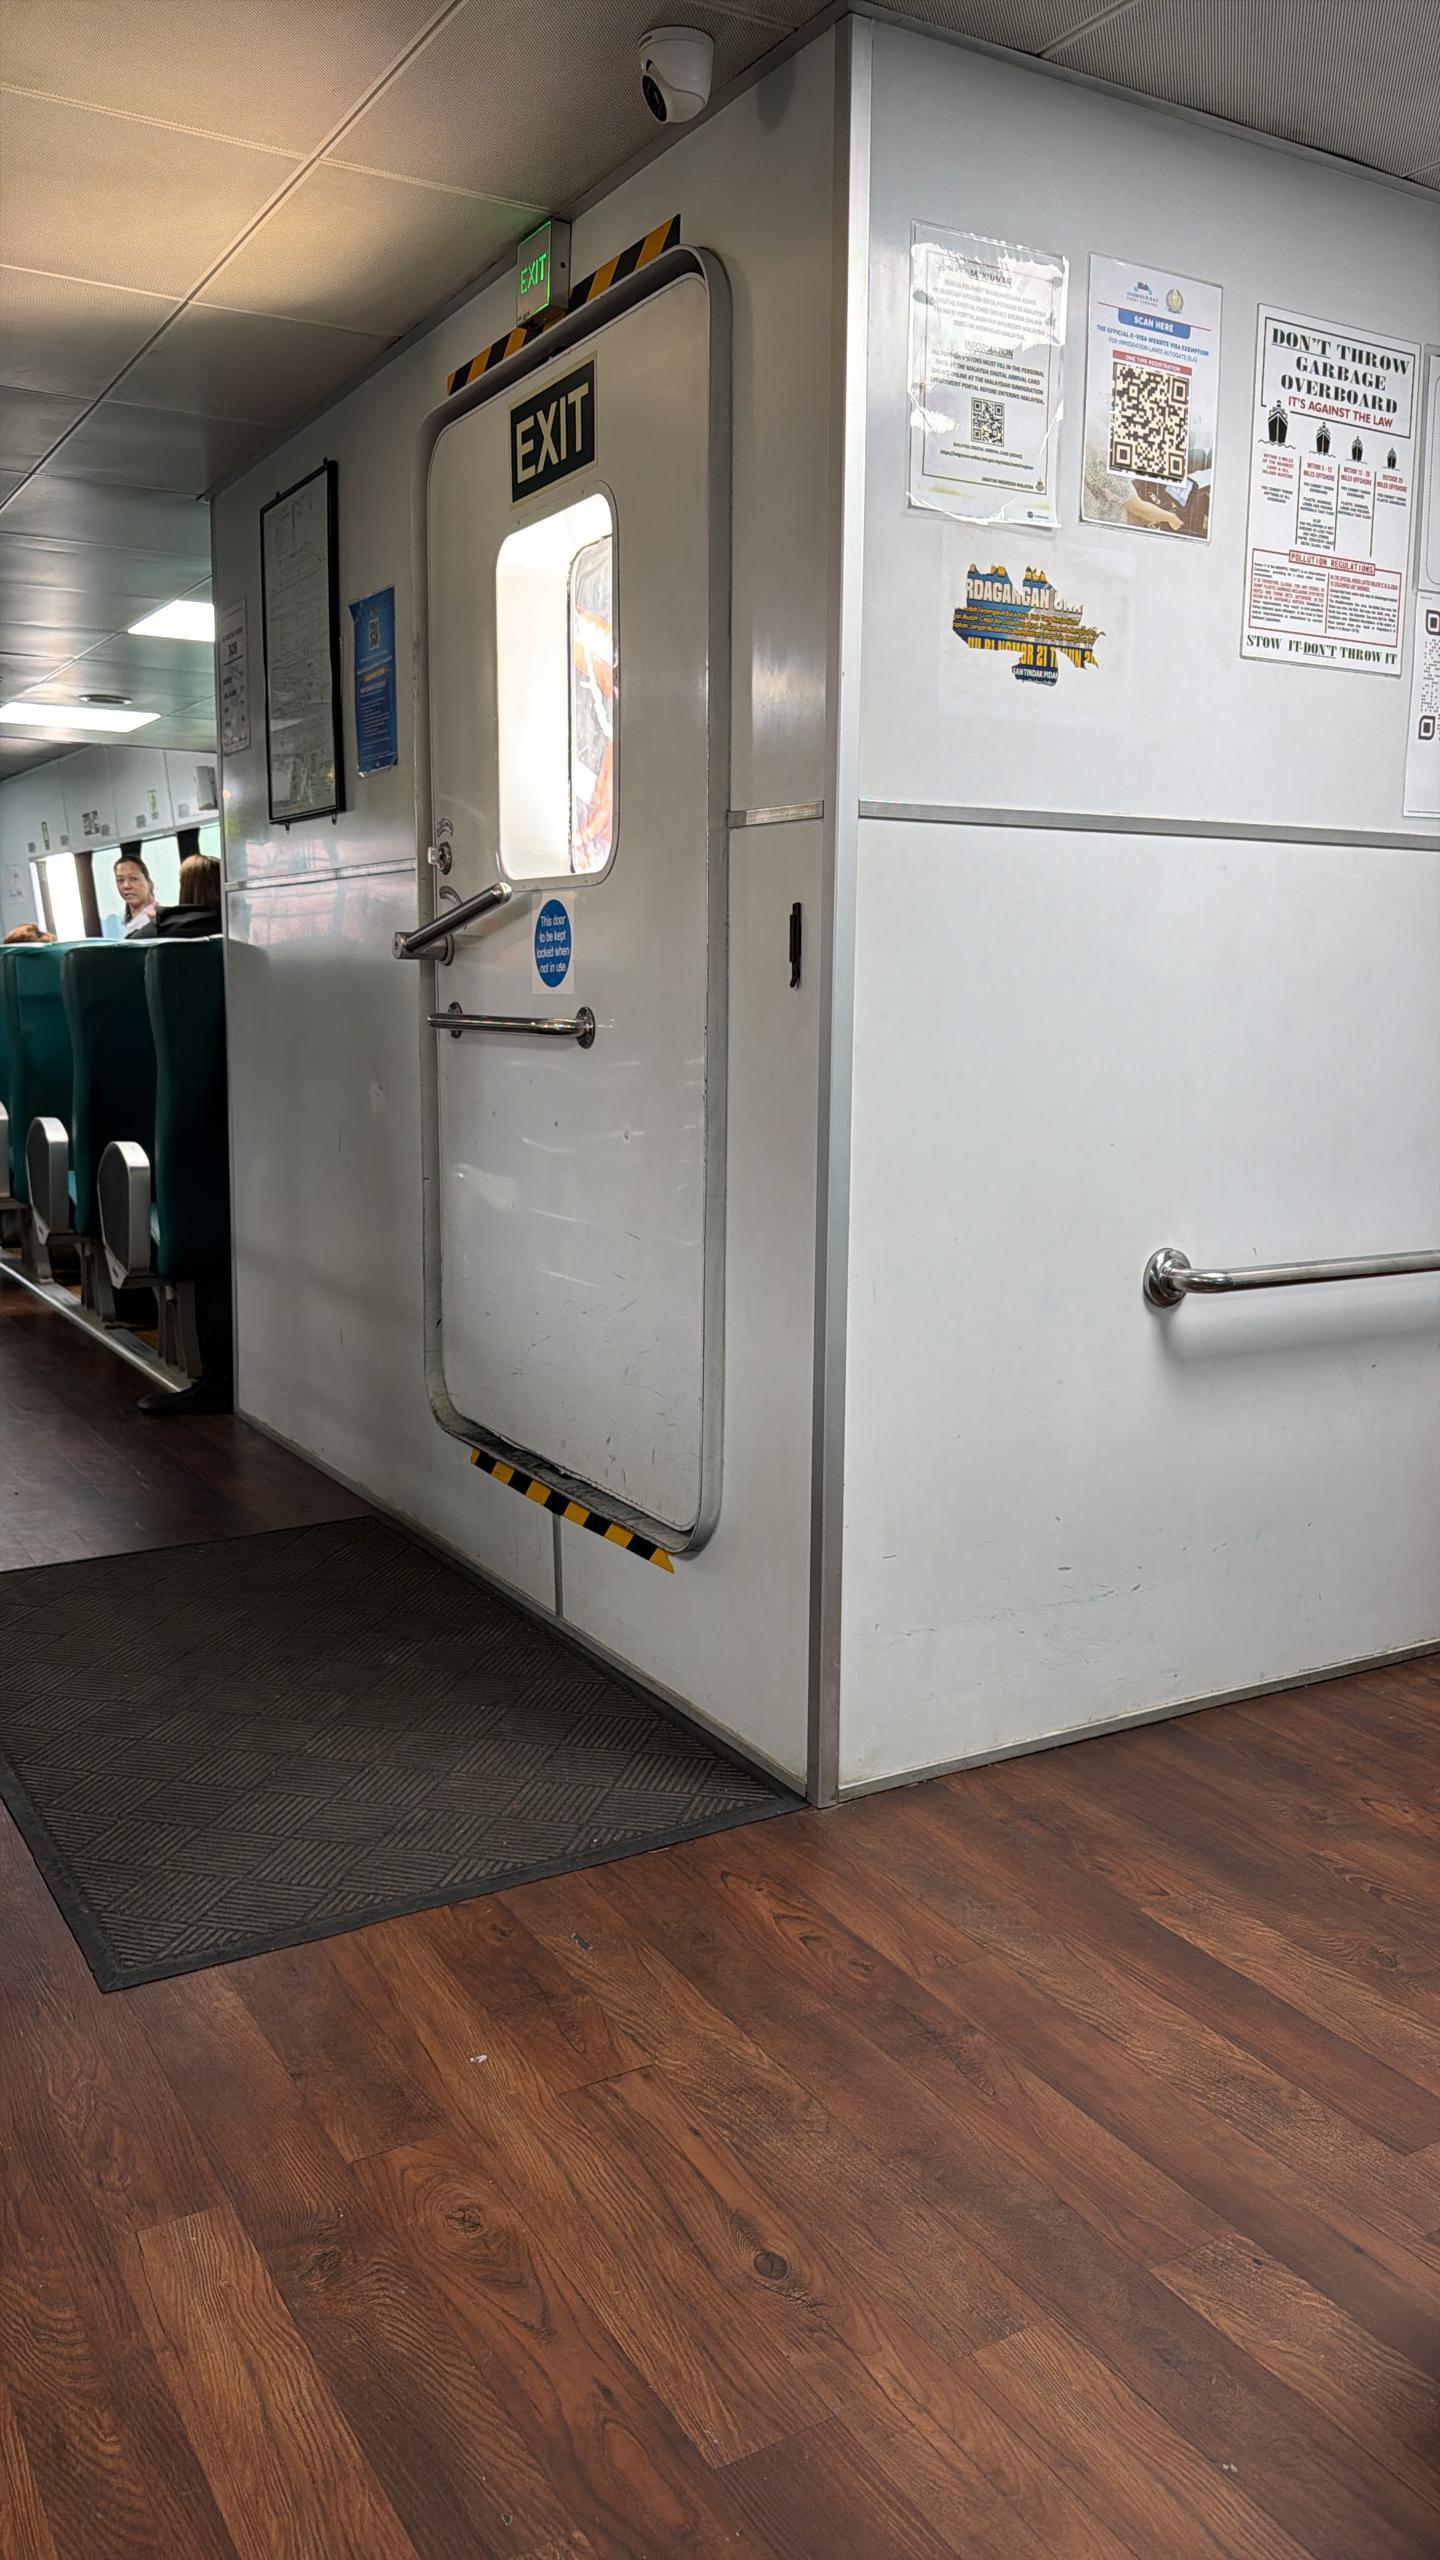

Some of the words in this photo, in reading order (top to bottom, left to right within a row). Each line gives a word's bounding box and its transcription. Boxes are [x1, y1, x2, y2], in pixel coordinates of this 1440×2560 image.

[520, 253, 547, 295] EXIT
[1133, 315, 1154, 327] SCAN
[1155, 320, 1174, 333] HERE
[1097, 324, 1106, 332] THE
[1107, 327, 1129, 338] OFFICIAL
[1130, 332, 1147, 342] E-VISA
[1148, 337, 1169, 347] WEBSITE
[1170, 341, 1181, 350] VISA
[1182, 344, 1209, 357] EXEMPTION
[1120, 339, 1148, 352] IMMIGRATION
[1164, 348, 1186, 360] AUTOGATE
[1272, 327, 1331, 357] DON'T
[1336, 344, 1410, 375] THROW
[983, 359, 996, 367] MUST
[997, 361, 1005, 369] FILL
[1021, 366, 1044, 377] PERSONAL
[1125, 354, 1136, 362] ONE
[1136, 356, 1148, 365] TIME
[1148, 359, 1181, 372] REGISTRATION
[956, 362, 965, 370] THE
[966, 364, 989, 375] MALAYSIA
[990, 370, 1007, 379] DIGITAL
[1008, 374, 1027, 383] ARRIVAL
[1027, 378, 1040, 386] CARD
[1296, 356, 1387, 391] GARBAGE
[962, 382, 979, 391] PORTAL
[980, 386, 997, 395] BEFORE
[998, 390, 1020, 400] ENTERING
[975, 375, 984, 383] THE
[984, 377, 1011, 389] MALAYSIAN
[1012, 382, 1044, 395] IMMIGRATION
[1281, 374, 1398, 414] OVERBOARD
[1288, 396, 1306, 409] IT'S
[1308, 400, 1351, 419] AGAINST
[1353, 410, 1371, 423] THE
[1373, 416, 1393, 428] LAW
[516, 382, 589, 485] EXIT
[1307, 462, 1320, 470] WITHIN
[1343, 466, 1357, 474] WITHIN
[1316, 473, 1335, 482] OFFSHORE
[1353, 476, 1372, 486] OFFSHORE
[1377, 481, 1388, 489] MILES
[1389, 483, 1407, 493] OFFSHORE
[1291, 553, 1327, 567] POLLUTION
[1331, 560, 1373, 574] REGULATIONS
[1036, 645, 1047, 667] 21
[1246, 634, 1282, 650] STOW
[1340, 646, 1383, 664] THROW
[1385, 652, 1398, 665] IT
[541, 915, 552, 928] This
[553, 914, 566, 926] door
[540, 931, 545, 943] to
[546, 930, 553, 942] be
[554, 929, 566, 943] kept
[537, 946, 554, 959] locked
[555, 946, 570, 957] when
[540, 962, 549, 974] not
[550, 962, 555, 974] in
[556, 962, 567, 973] use
